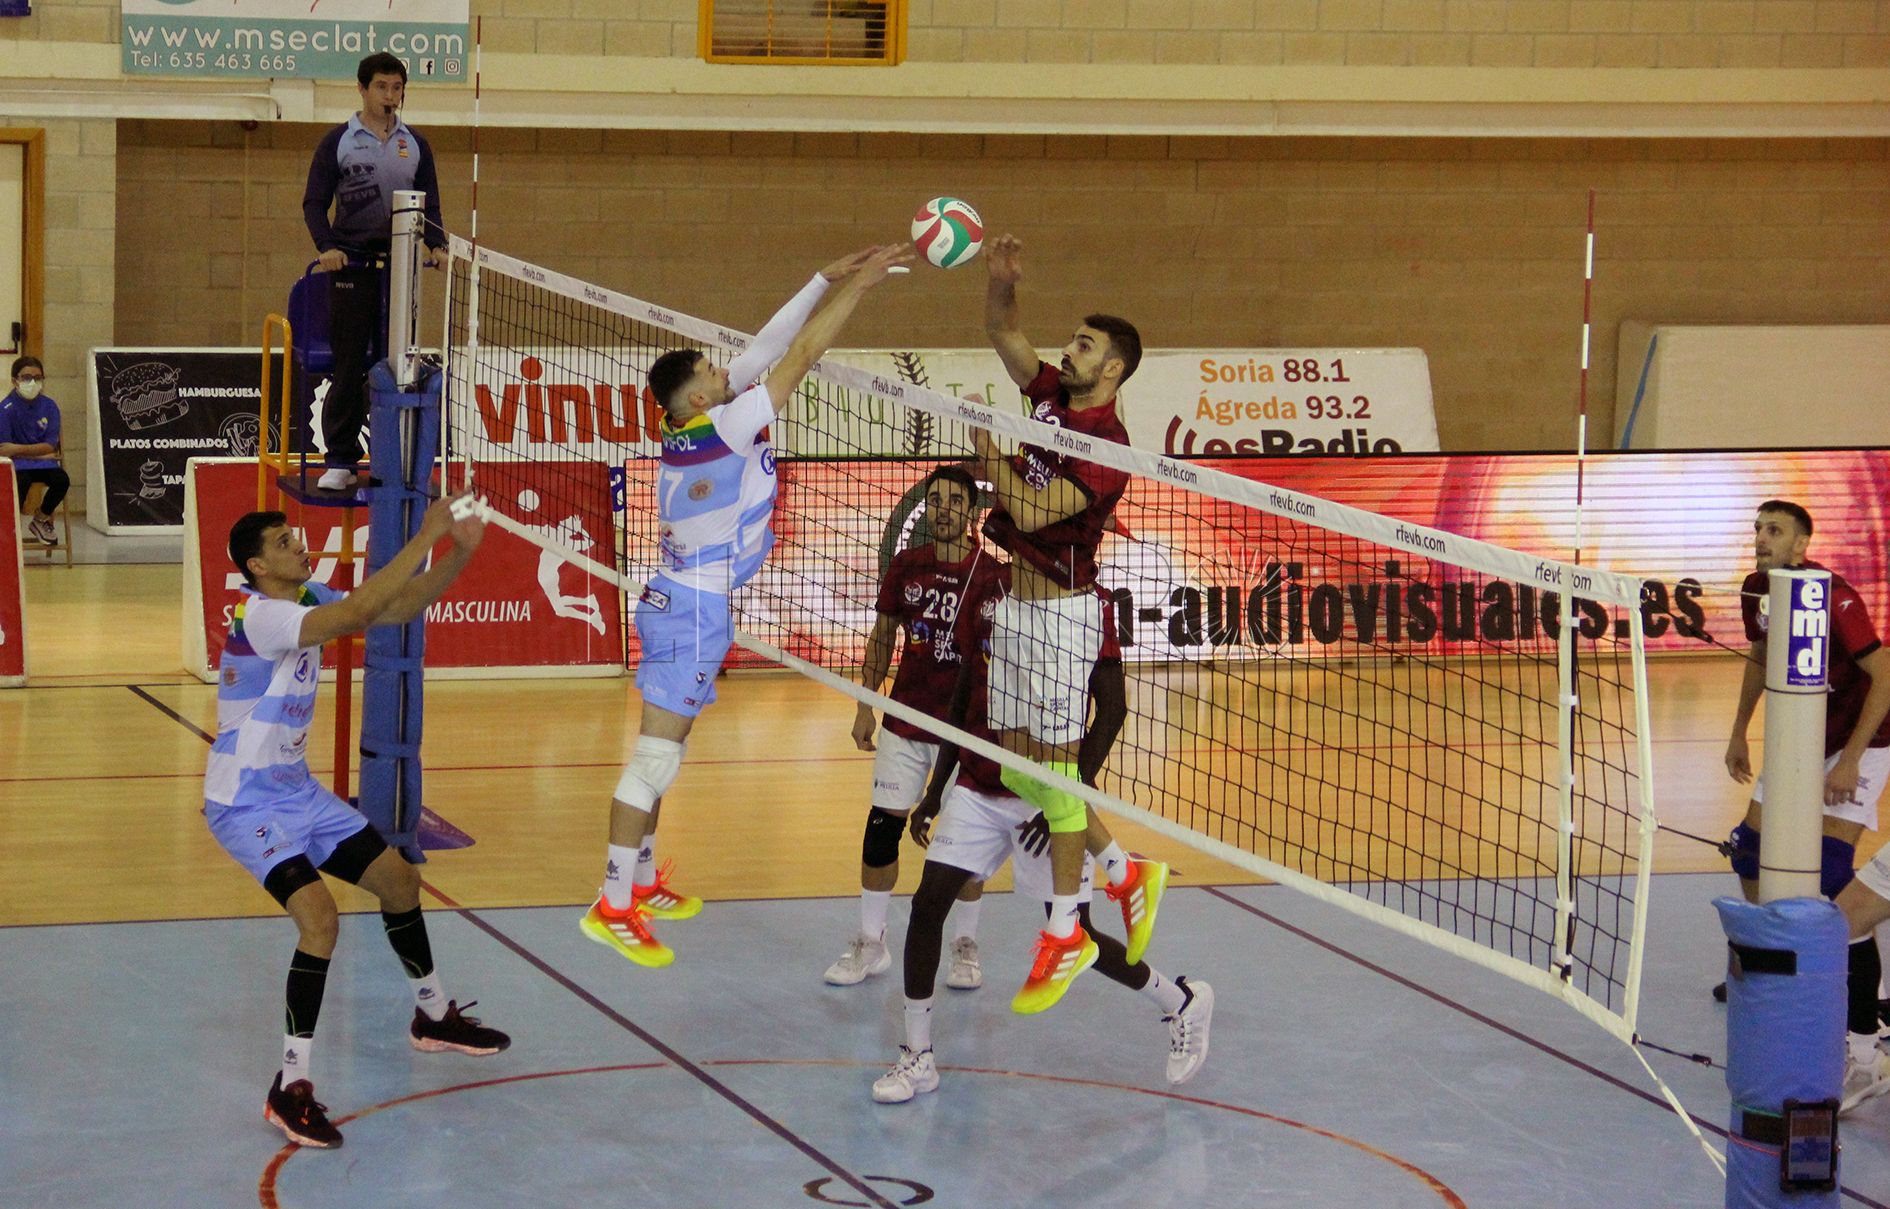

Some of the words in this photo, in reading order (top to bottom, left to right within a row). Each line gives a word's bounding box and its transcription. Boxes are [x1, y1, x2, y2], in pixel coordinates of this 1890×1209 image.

[128, 24, 464, 55] www.mseclat.com
[131, 51, 163, 68] Tel:
[169, 52, 206, 69] 635
[215, 53, 252, 70] 463
[259, 54, 297, 71] 665
[1200, 358, 1274, 384] Soria
[1283, 358, 1350, 383] 88.1
[1196, 389, 1297, 427] Ágreda
[1306, 395, 1371, 420] 93.2
[110, 439, 151, 449] PLATOS
[153, 438, 229, 449] COMBINADOS
[1054, 431, 1092, 454] rfevb.com
[1157, 458, 1197, 485] rfevb.com
[1269, 490, 1316, 518] rfevb.com
[1396, 525, 1446, 554] rfevb.com
[425, 600, 531, 625] MASCULINA
[922, 588, 959, 623] 28
[1793, 581, 1827, 677] emd
